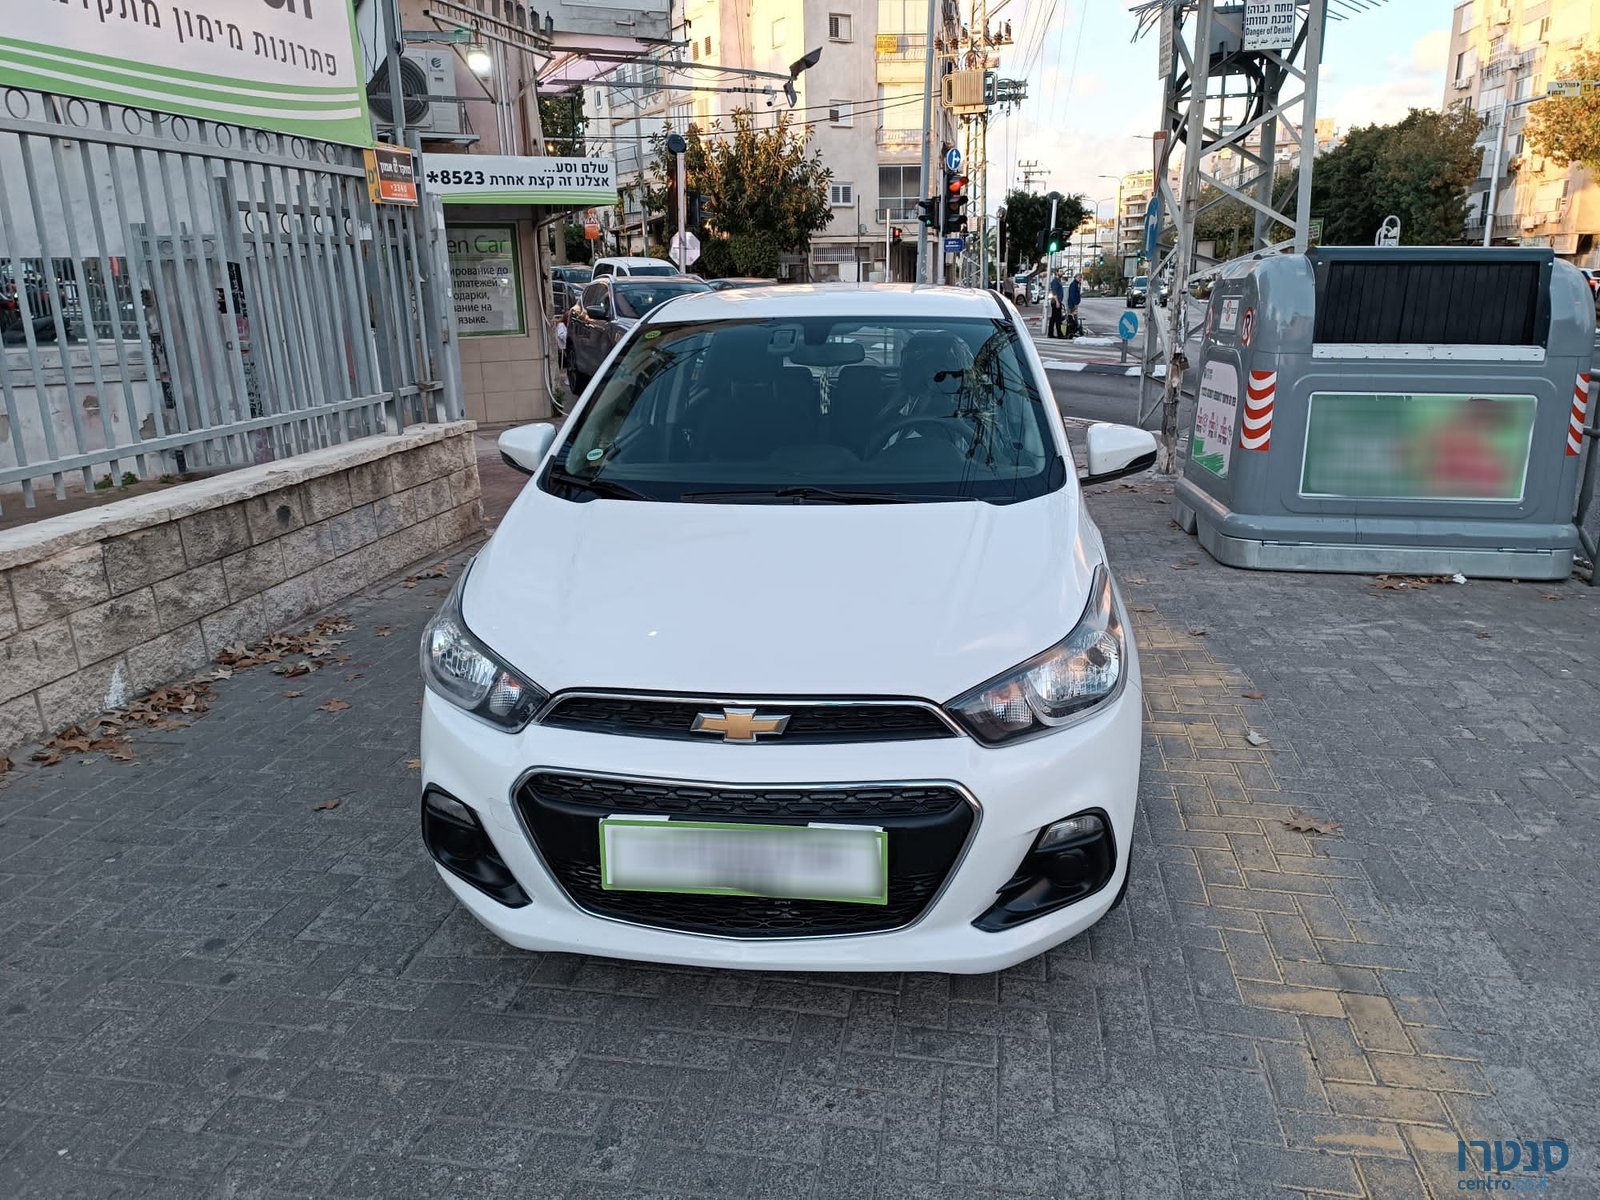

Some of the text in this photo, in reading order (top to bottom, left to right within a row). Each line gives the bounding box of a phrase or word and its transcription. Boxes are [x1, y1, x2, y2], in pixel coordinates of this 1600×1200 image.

[1247, 4, 1293, 14] מתח גבוה!
[1246, 15, 1292, 26] סכנת מוות!
[172, 6, 243, 51] מימון
[1245, 25, 1292, 37] Danger of Death!
[252, 31, 337, 76] פתרונות
[1583, 84, 1591, 92] 13
[544, 161, 608, 173] שלם וסע...
[489, 175, 524, 186] אחרת
[528, 175, 555, 189] קצת
[558, 176, 572, 186] זה
[576, 175, 609, 187] אצלנו
[447, 235, 506, 253] en Car
[450, 266, 508, 278] ирование до
[453, 291, 490, 303] одарки,
[454, 303, 492, 312] ание на
[458, 315, 489, 325] языке.
